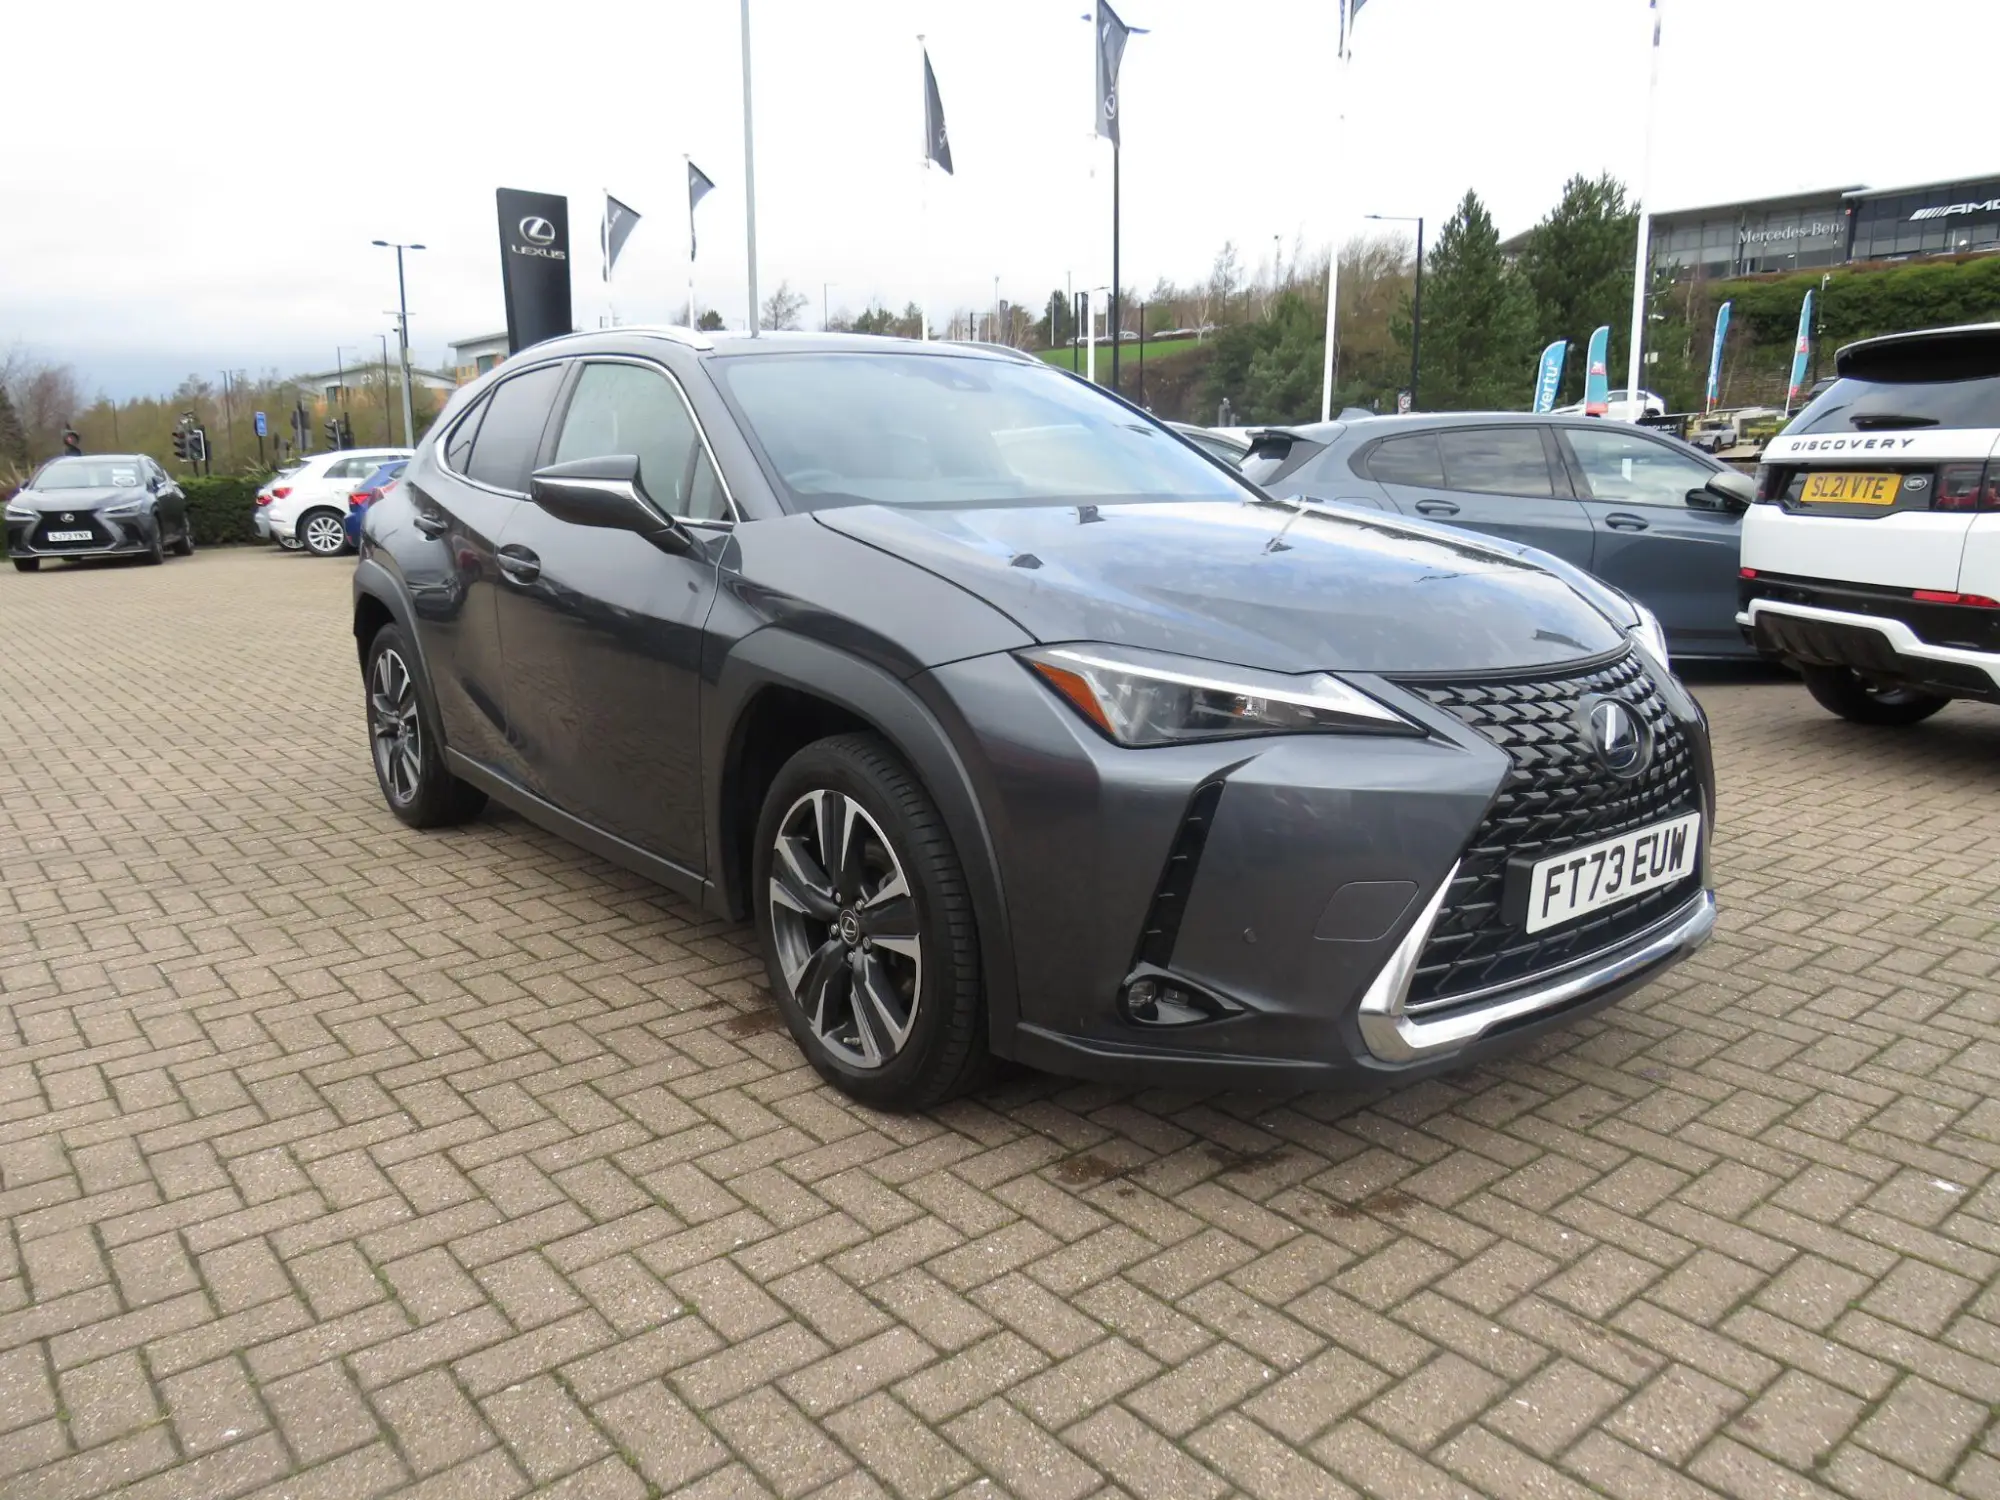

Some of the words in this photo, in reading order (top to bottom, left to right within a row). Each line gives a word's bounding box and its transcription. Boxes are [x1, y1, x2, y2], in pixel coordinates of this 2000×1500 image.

[511, 244, 566, 260] LEXUS
[1539, 366, 1559, 412] vertu
[1791, 438, 1914, 451] DISCOVERY
[1811, 476, 1847, 498] SL21
[1851, 477, 1888, 499] VTE
[1542, 845, 1626, 919] FT73
[1630, 823, 1688, 886] EUW
